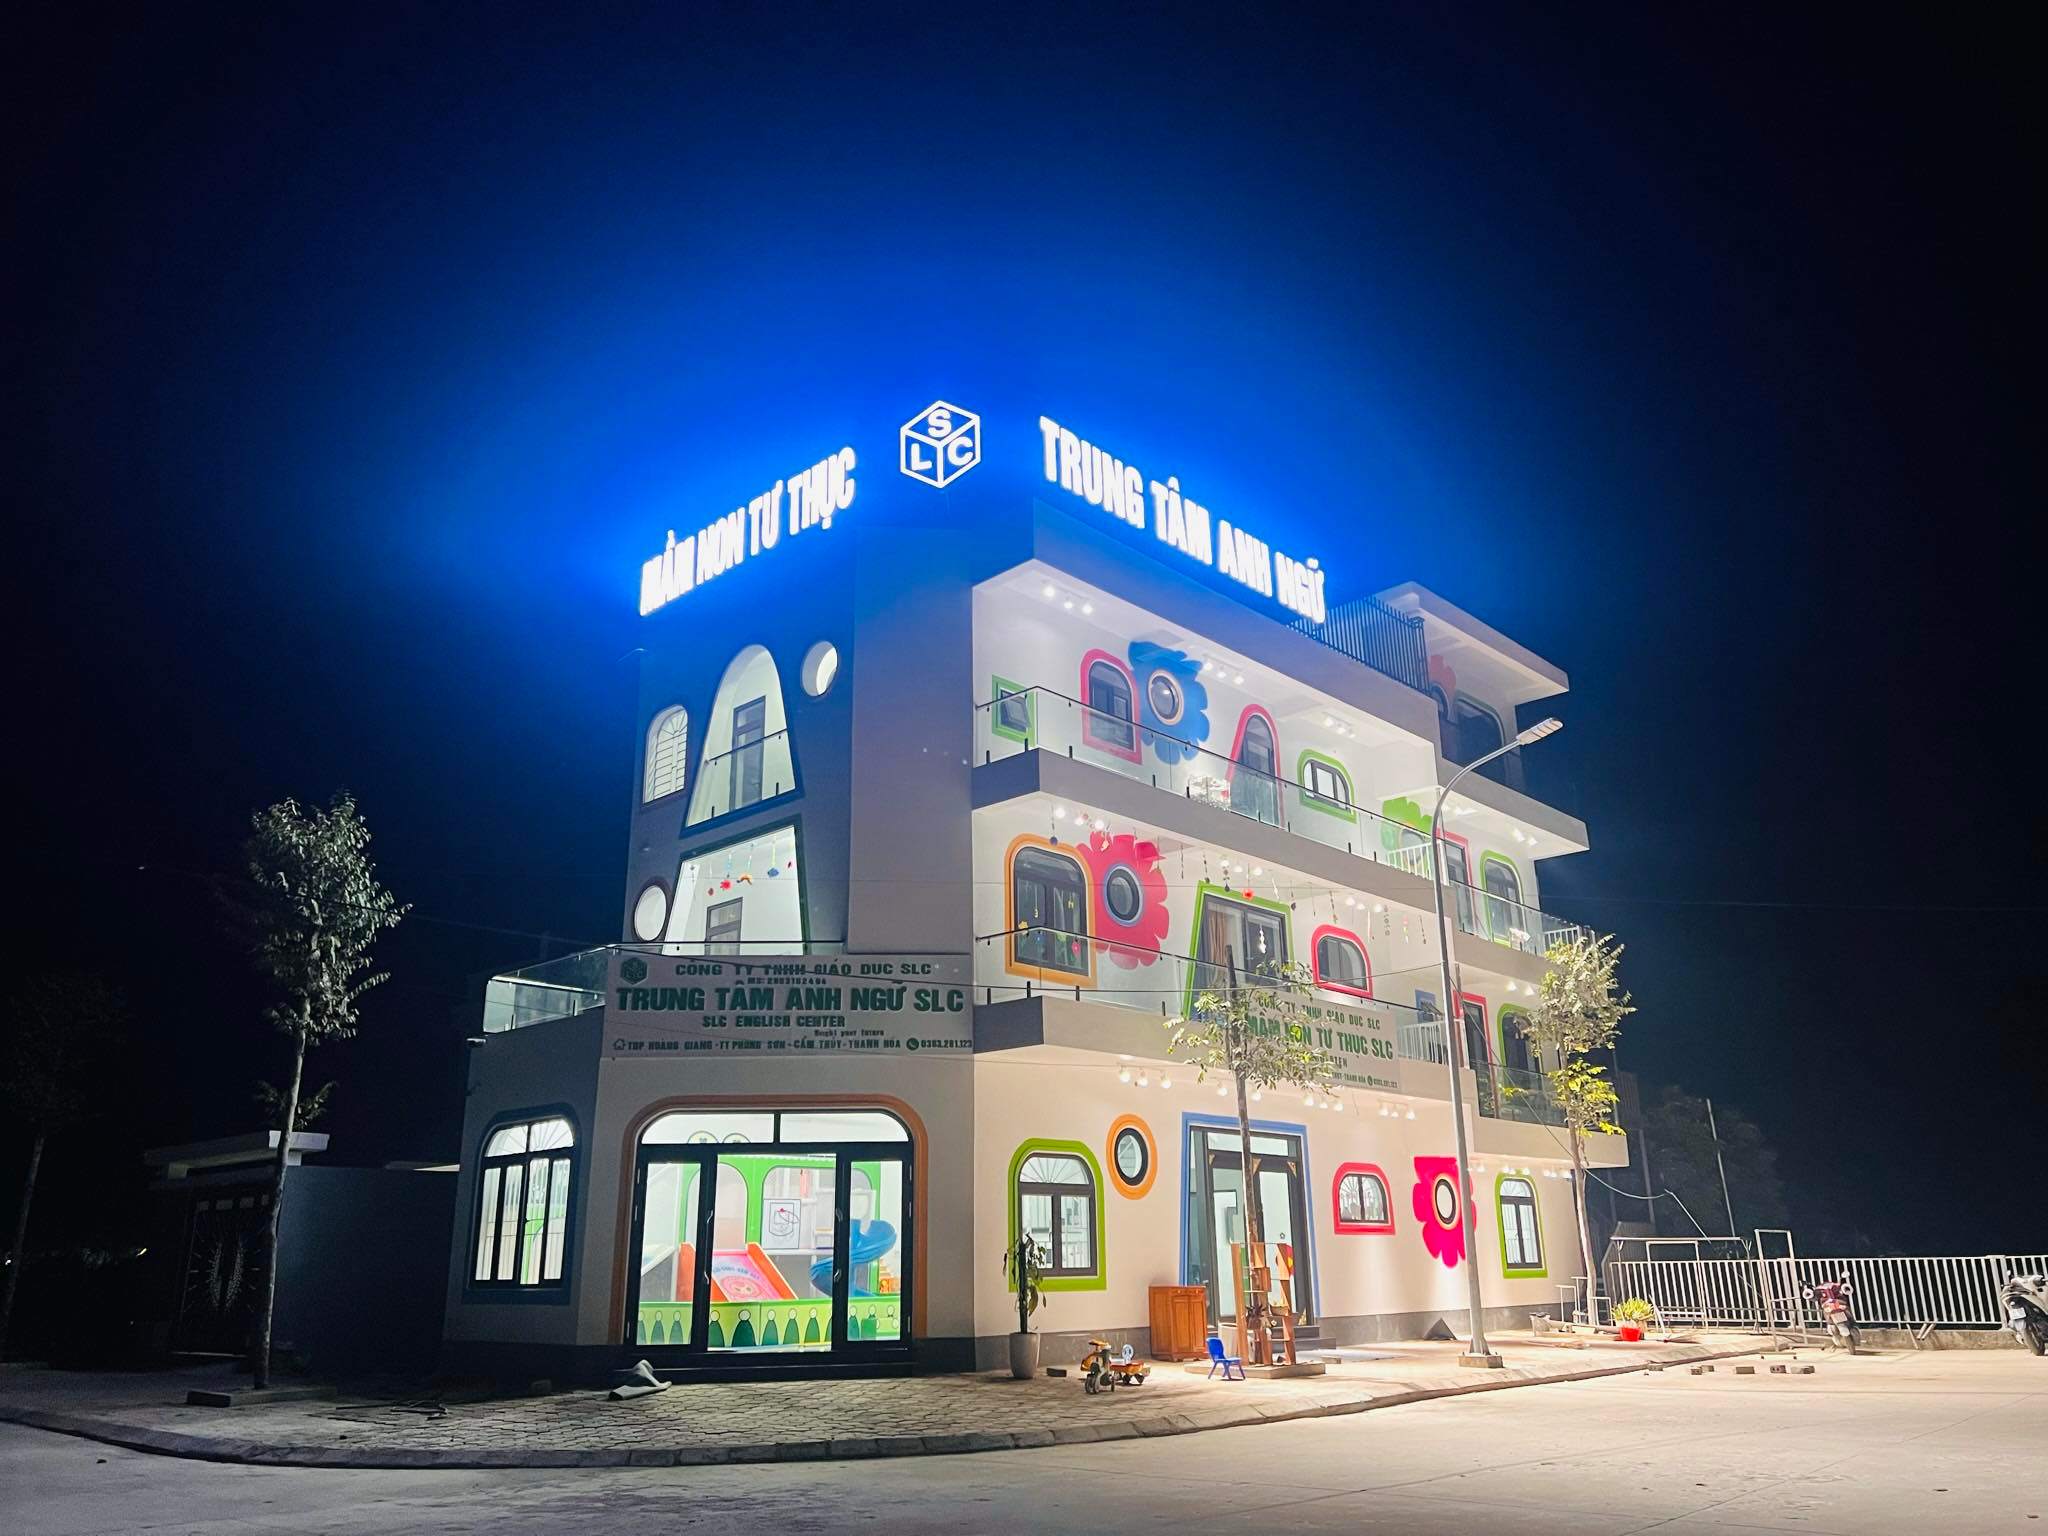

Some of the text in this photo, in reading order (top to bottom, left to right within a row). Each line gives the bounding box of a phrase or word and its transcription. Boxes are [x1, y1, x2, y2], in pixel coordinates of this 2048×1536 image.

[1040, 416, 1145, 529] TRUNG
[1151, 476, 1212, 565] TÂM
[1217, 519, 1273, 598] ANH
[697, 507, 745, 585] NON
[749, 479, 783, 556] TƯ
[675, 959, 722, 976] CÔNG
[735, 964, 752, 976] TY
[901, 963, 931, 975] SLC
[616, 979, 964, 1012] TRUNG TÂM ANH NGỮ SLC
[702, 1015, 845, 1028] SLC ENGLISH CENTER
[1367, 1018, 1380, 1030] SLC
[1316, 1027, 1333, 1049] TƯ
[1336, 1032, 1368, 1058] THỤC
[1371, 1037, 1393, 1060] SLC
